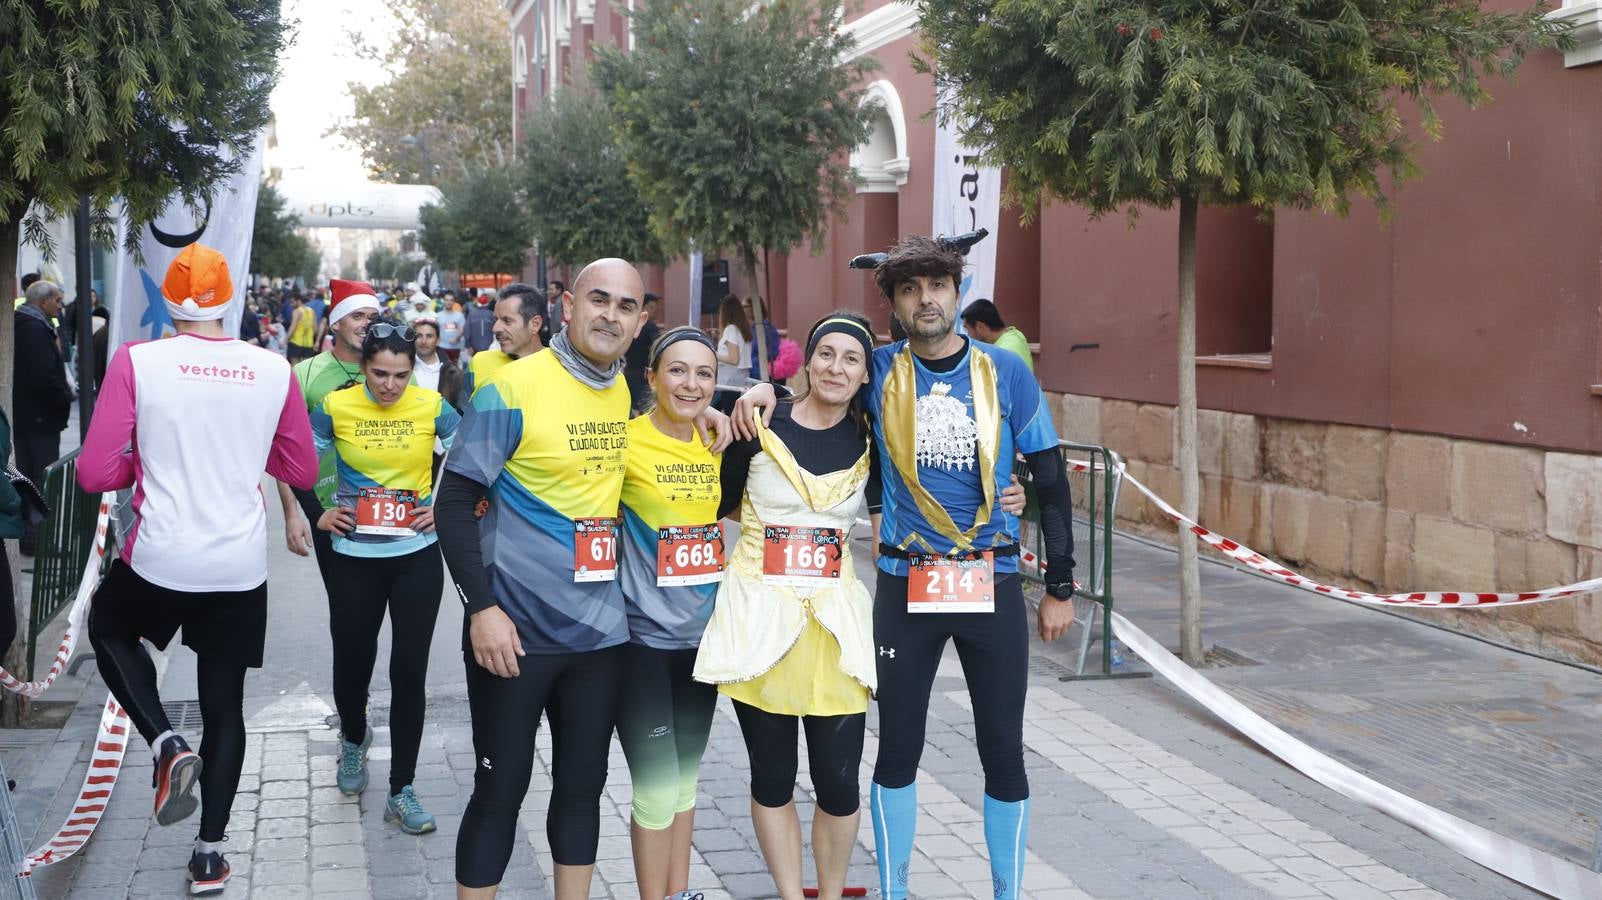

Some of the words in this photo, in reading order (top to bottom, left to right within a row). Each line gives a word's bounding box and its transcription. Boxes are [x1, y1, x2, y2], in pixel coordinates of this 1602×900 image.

[309, 200, 374, 217] dpts
[178, 364, 255, 380] vectoris
[364, 420, 379, 428] SAN
[380, 420, 414, 428] SILVESTRE
[566, 424, 578, 435] VI
[579, 422, 596, 435] SAN
[355, 428, 380, 436] CIUDAD
[381, 428, 390, 436] DE
[392, 428, 415, 436] LORCA
[569, 438, 599, 451] CIUDAD
[600, 438, 609, 450] DE
[655, 464, 665, 472] VI
[666, 464, 684, 473] SAN
[656, 474, 687, 484] CIUDAD
[688, 475, 698, 484] DE
[372, 502, 406, 522] 130
[660, 530, 668, 539] VI
[813, 535, 839, 545] LORCA
[675, 543, 714, 568] 669
[784, 545, 827, 570] 166
[911, 557, 919, 566] VI
[927, 571, 975, 594] 214
